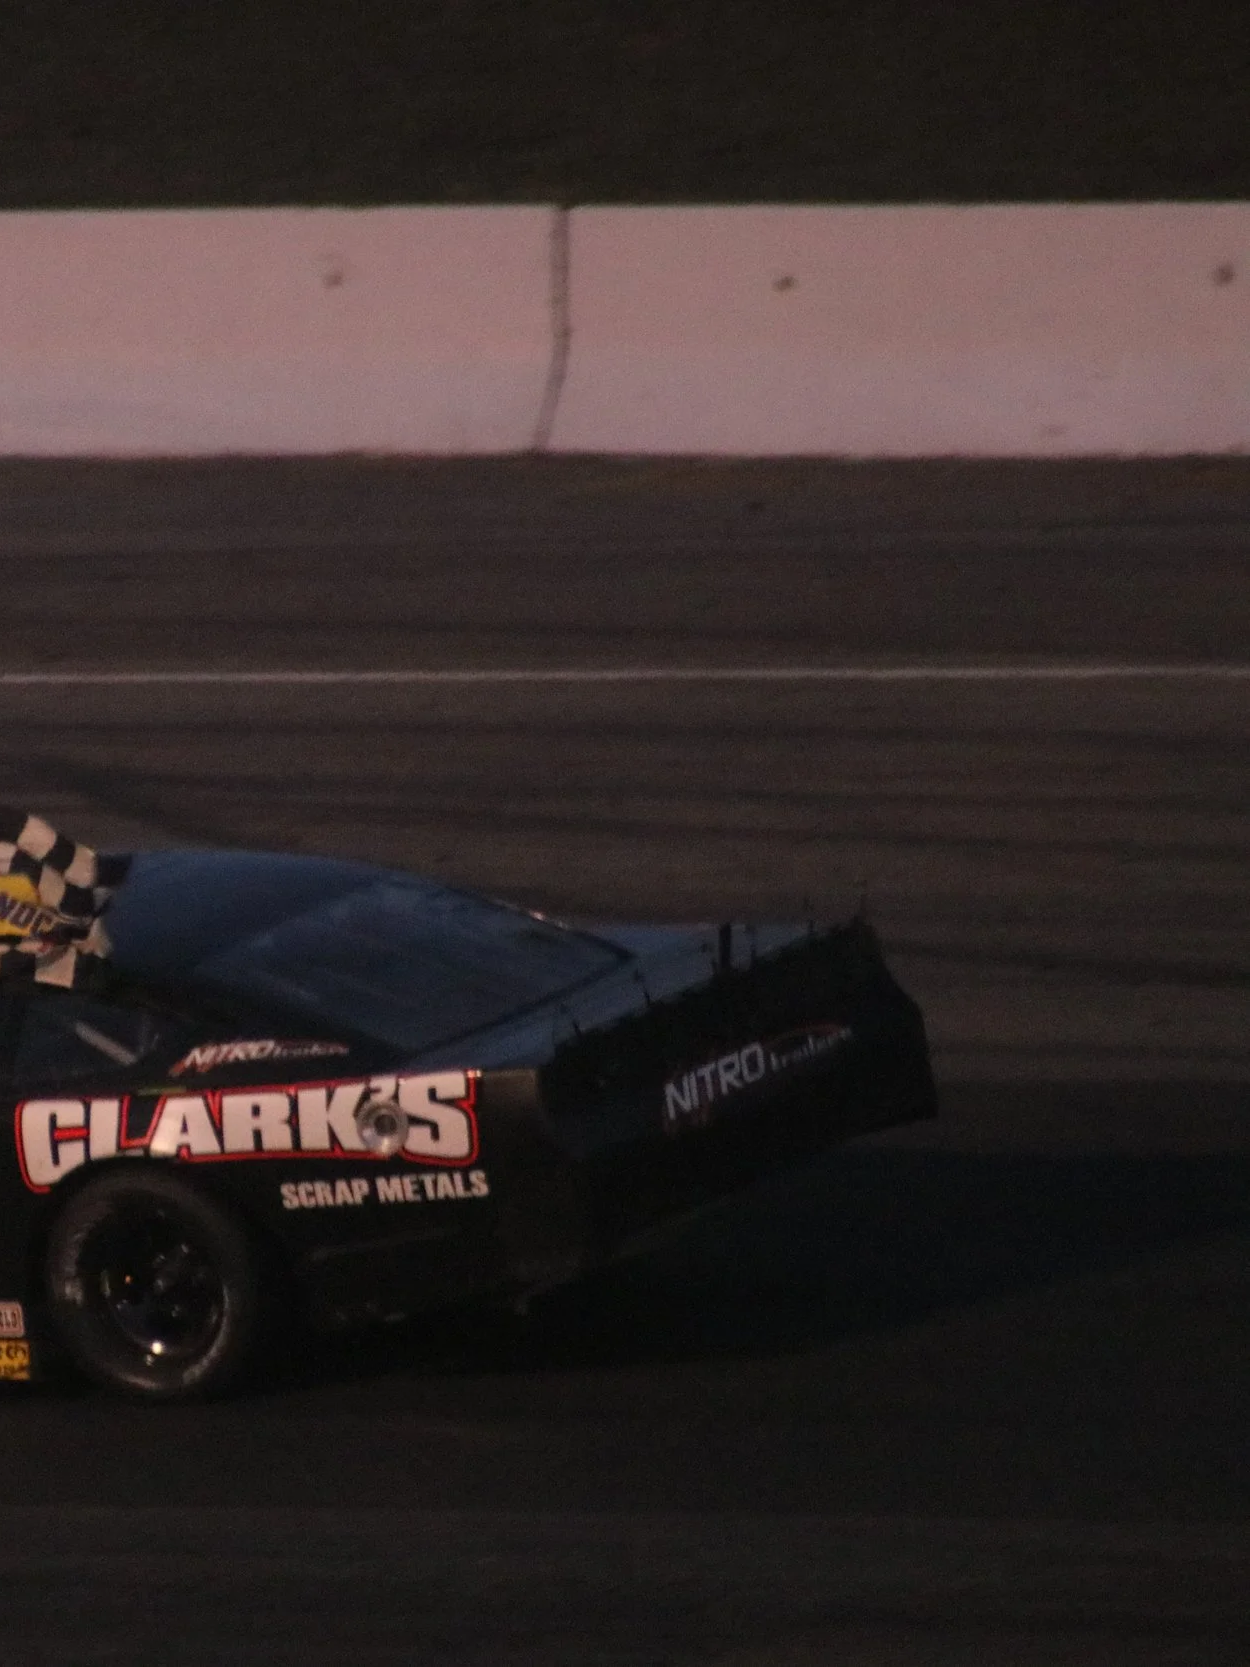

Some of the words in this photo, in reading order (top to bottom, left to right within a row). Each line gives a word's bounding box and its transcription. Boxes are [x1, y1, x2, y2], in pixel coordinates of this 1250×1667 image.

[171, 1040, 277, 1076] NITRO
[663, 1041, 765, 1121] NITRO
[16, 1070, 478, 1192] CLARK'S
[280, 1179, 369, 1211] SCRAP
[378, 1169, 490, 1204] METALS
